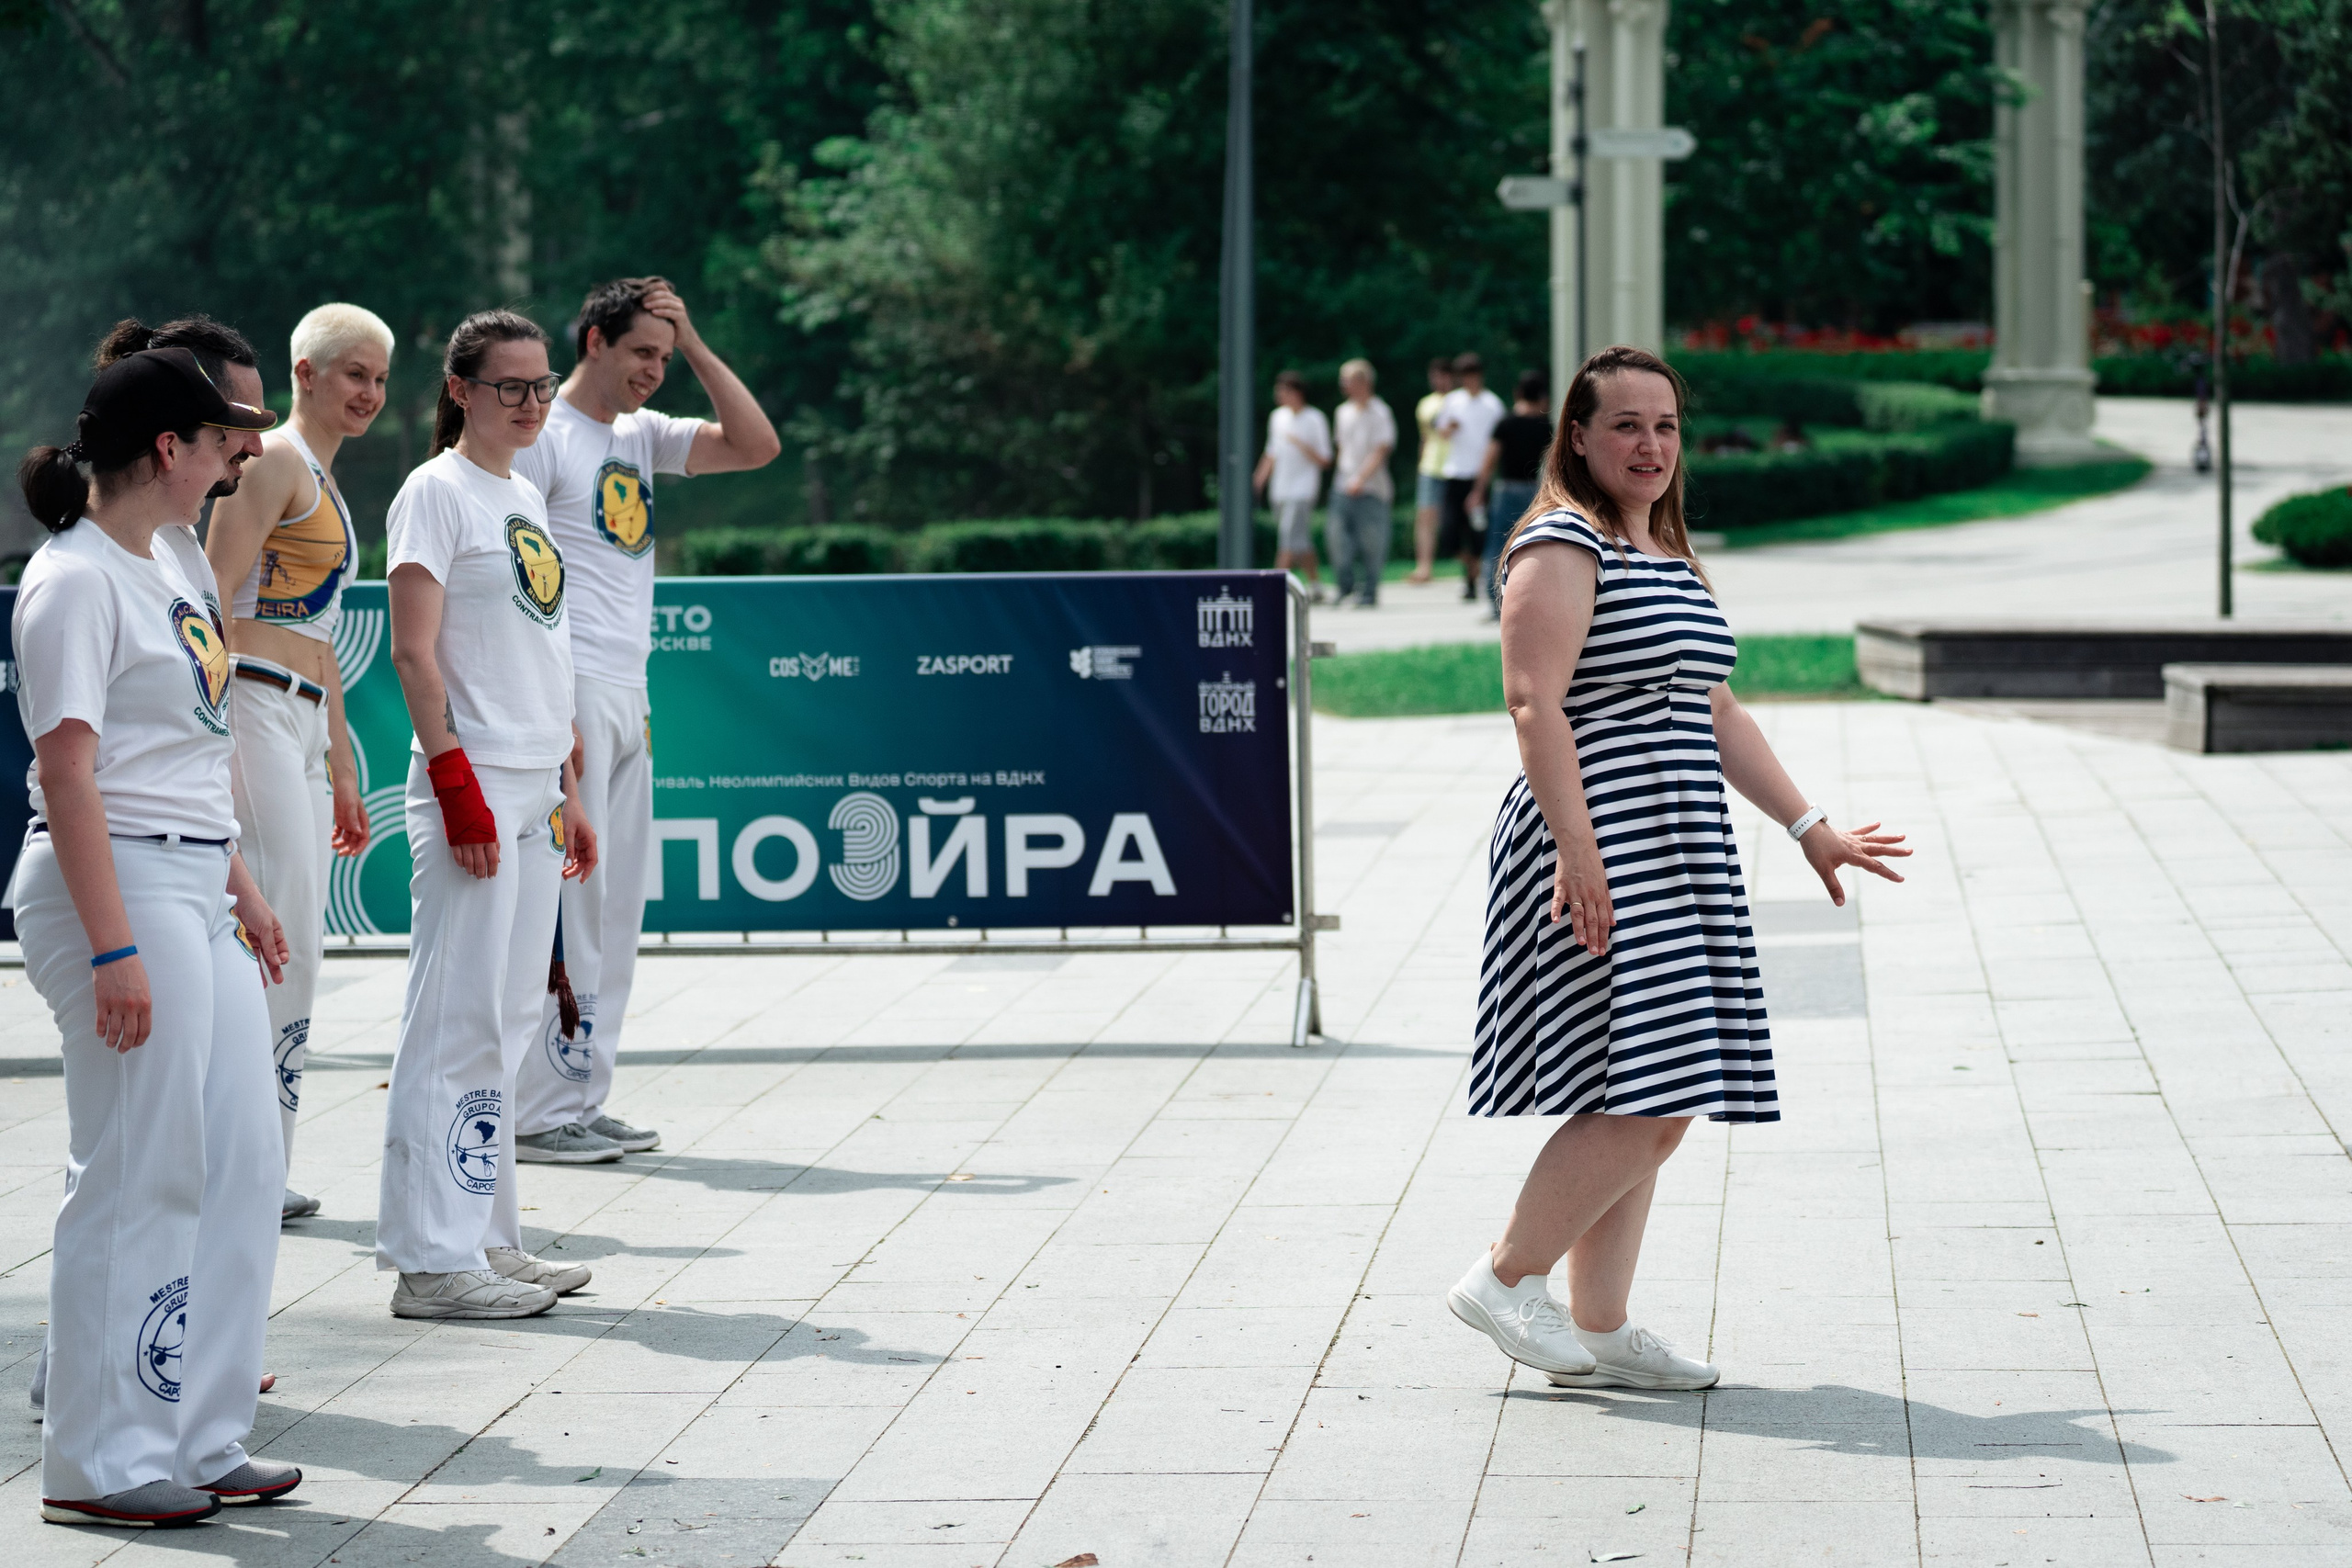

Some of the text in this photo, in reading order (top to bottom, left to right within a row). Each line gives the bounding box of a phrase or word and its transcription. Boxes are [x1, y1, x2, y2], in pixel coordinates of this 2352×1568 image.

[917, 654, 1013, 675] ZASPORT
[1199, 693, 1256, 716] ГОРОД
[1199, 716, 1257, 733] ВДНХ
[652, 770, 1046, 789] иваль Неолимпийских Видов Спорта на ВДНХ
[455, 1089, 487, 1111] MESTRE
[463, 1102, 495, 1120] GRUPO
[149, 1276, 189, 1304] MESTRE
